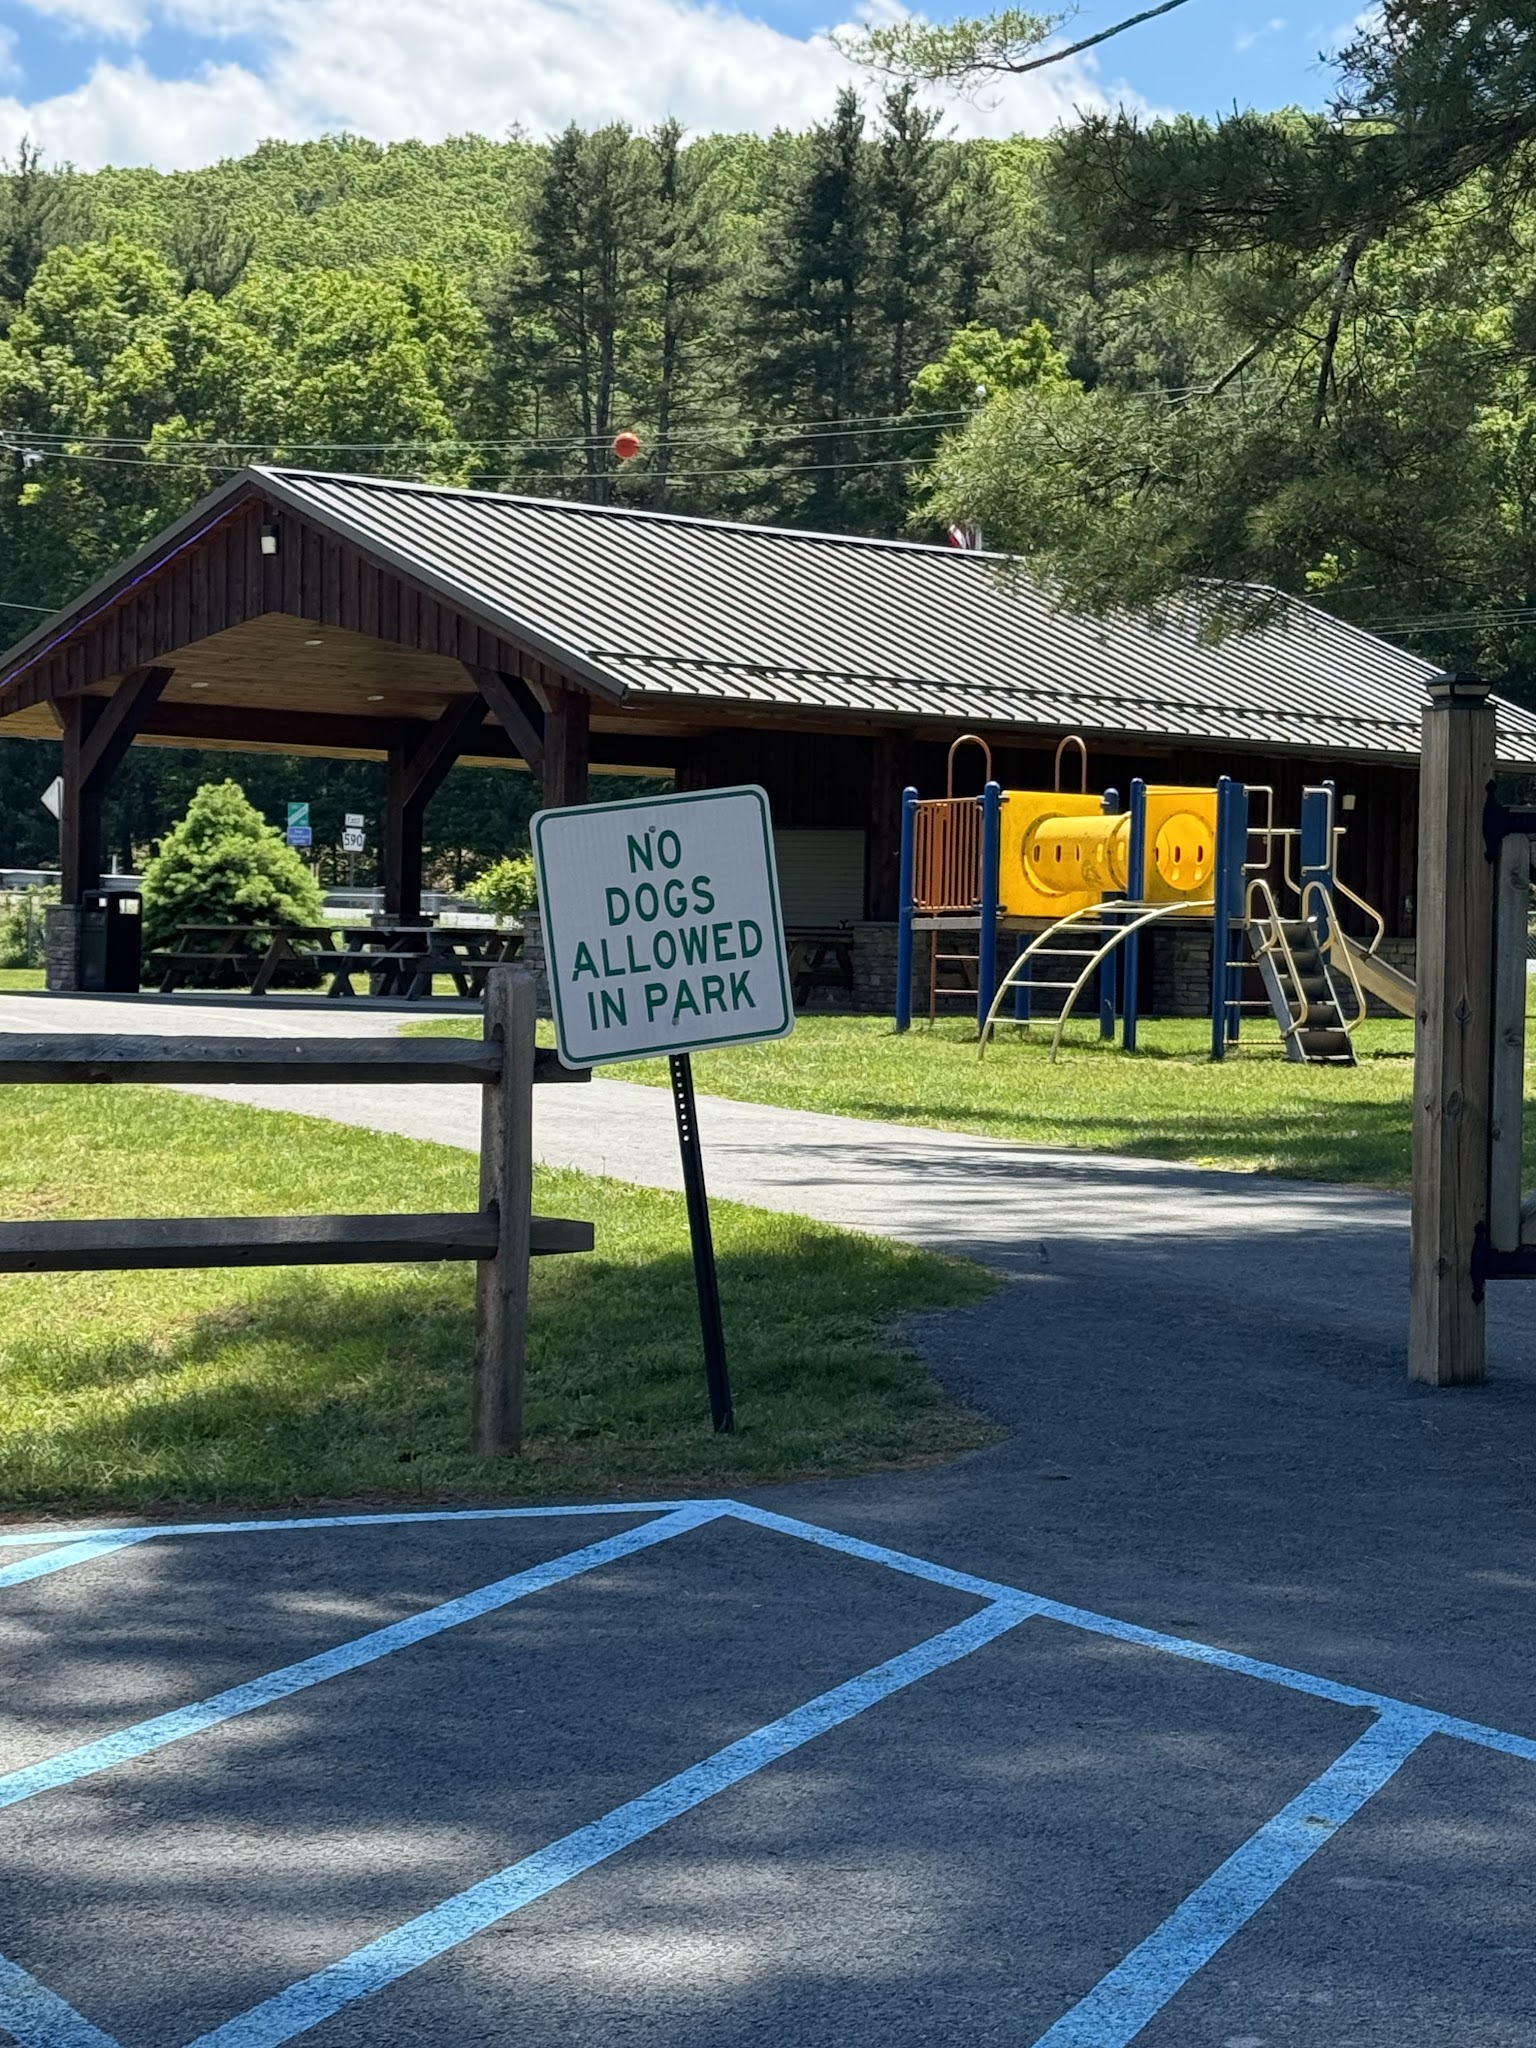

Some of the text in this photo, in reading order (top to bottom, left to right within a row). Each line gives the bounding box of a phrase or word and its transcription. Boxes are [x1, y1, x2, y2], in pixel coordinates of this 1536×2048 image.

[344, 833, 363, 847] 590
[627, 829, 682, 873] NO
[605, 875, 715, 926] DOGS
[571, 919, 763, 982] ALLOWED
[587, 970, 757, 1031] IN PARK
